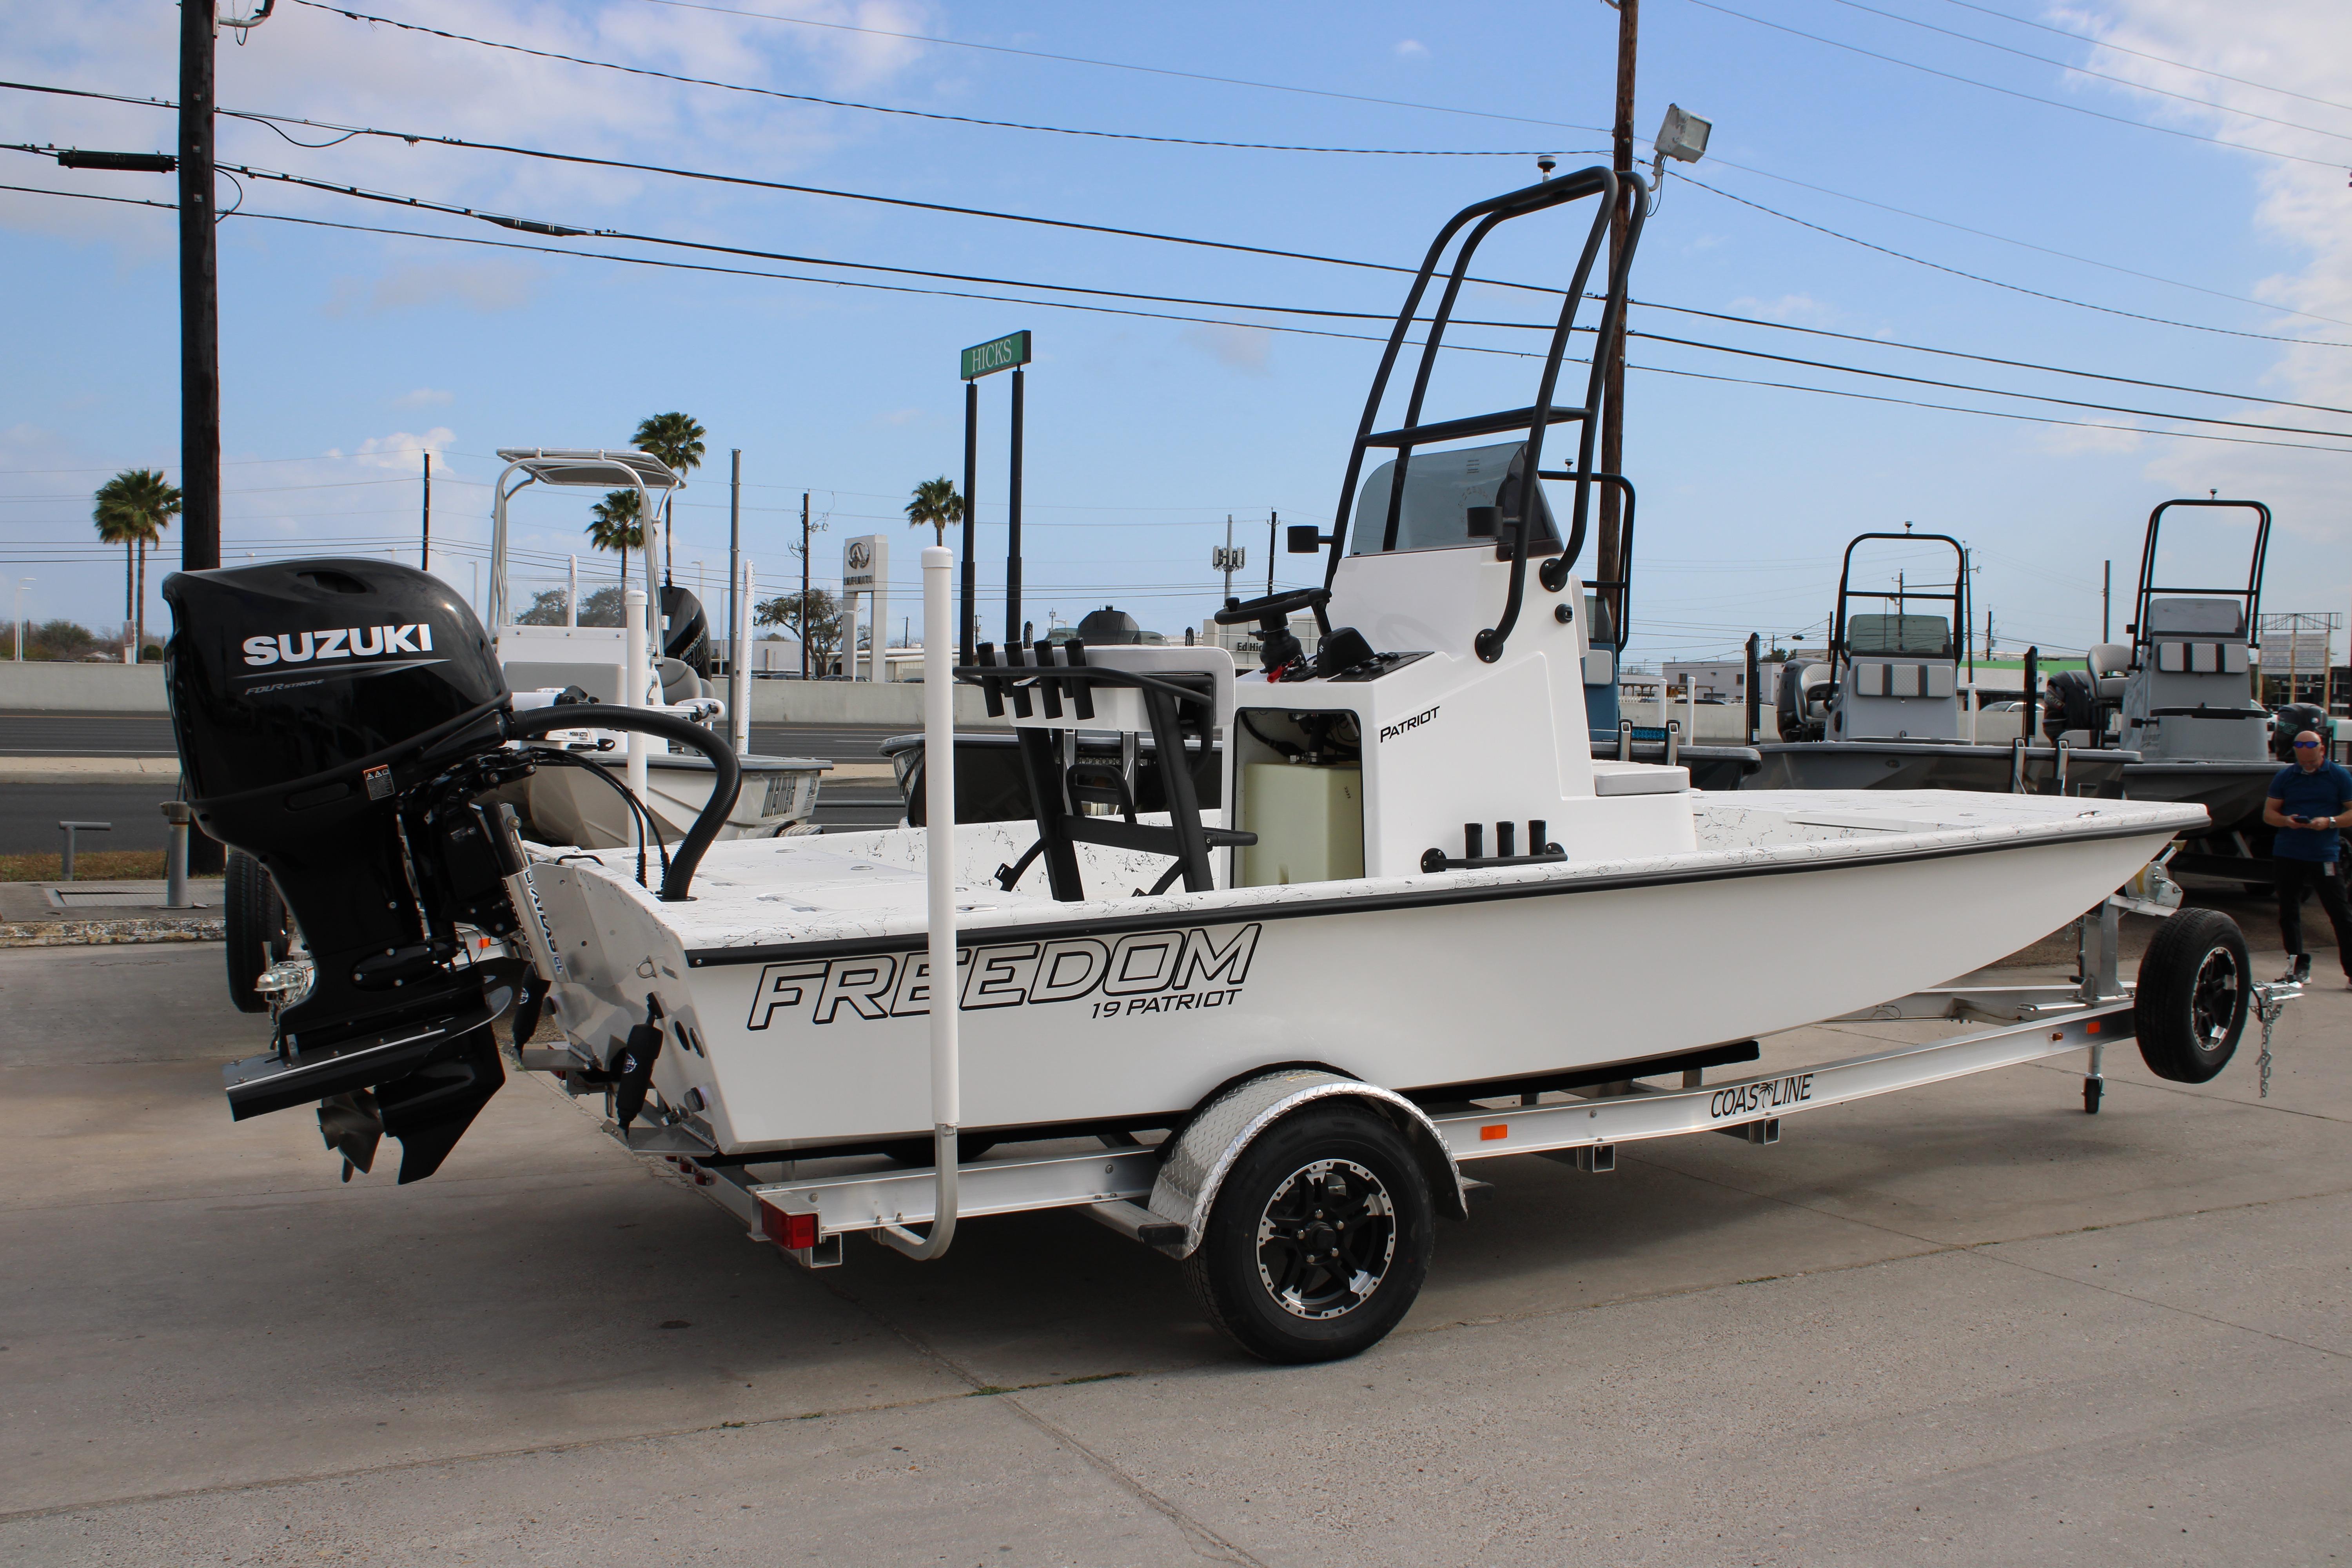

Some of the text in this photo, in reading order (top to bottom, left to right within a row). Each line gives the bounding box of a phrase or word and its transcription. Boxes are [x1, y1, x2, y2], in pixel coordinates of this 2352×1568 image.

[972, 339, 1011, 372] HICKS
[243, 624, 433, 666] SUZUKI
[1237, 641, 1262, 651] Ed Hic
[245, 679, 325, 695] FOUR STROKE
[1380, 706, 1440, 744] PATRIOT
[529, 887, 559, 955] ATLAS
[747, 923, 1262, 1031] FREEDOM
[1092, 988, 1243, 1019] 19 PATRIOT
